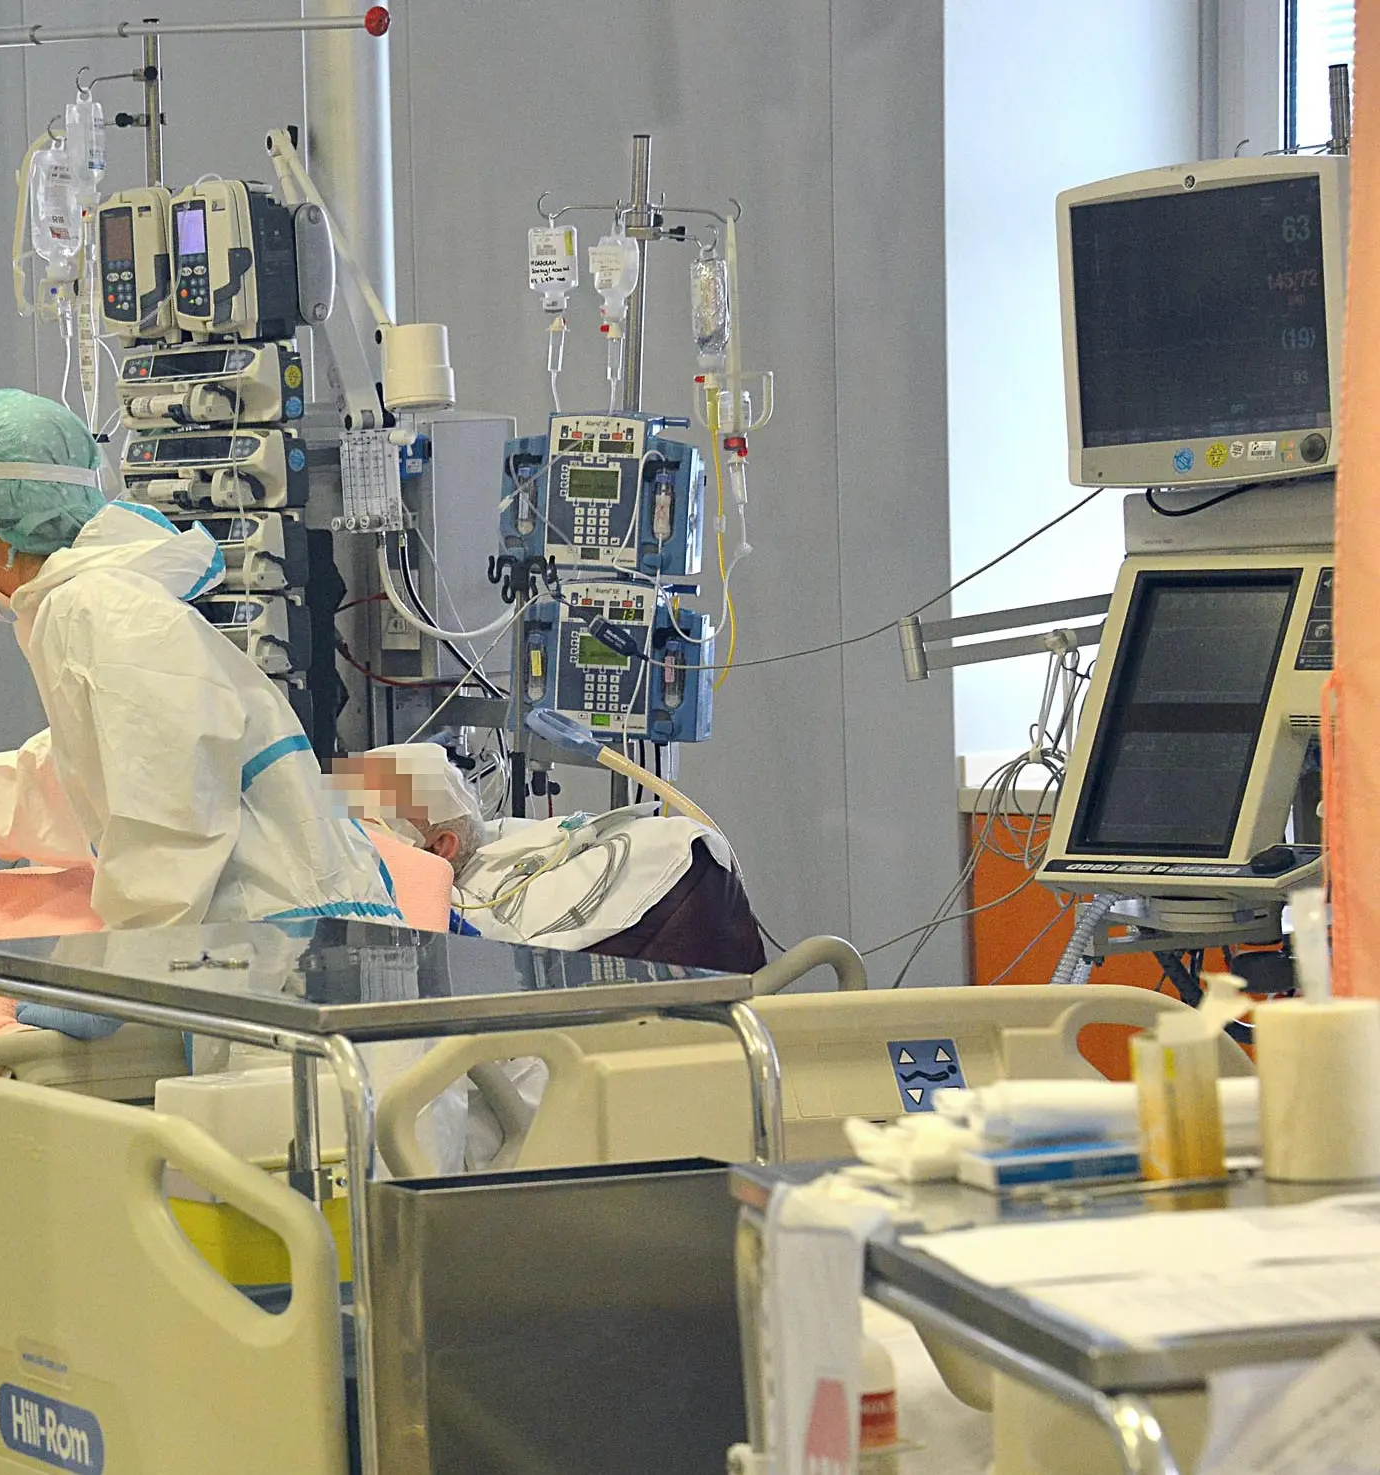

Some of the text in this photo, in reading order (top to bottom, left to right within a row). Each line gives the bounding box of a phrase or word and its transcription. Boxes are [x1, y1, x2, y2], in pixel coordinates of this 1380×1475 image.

[1282, 214, 1312, 244] 63
[622, 609, 636, 620] 13
[10, 1394, 90, 1467] Hill-Rom
